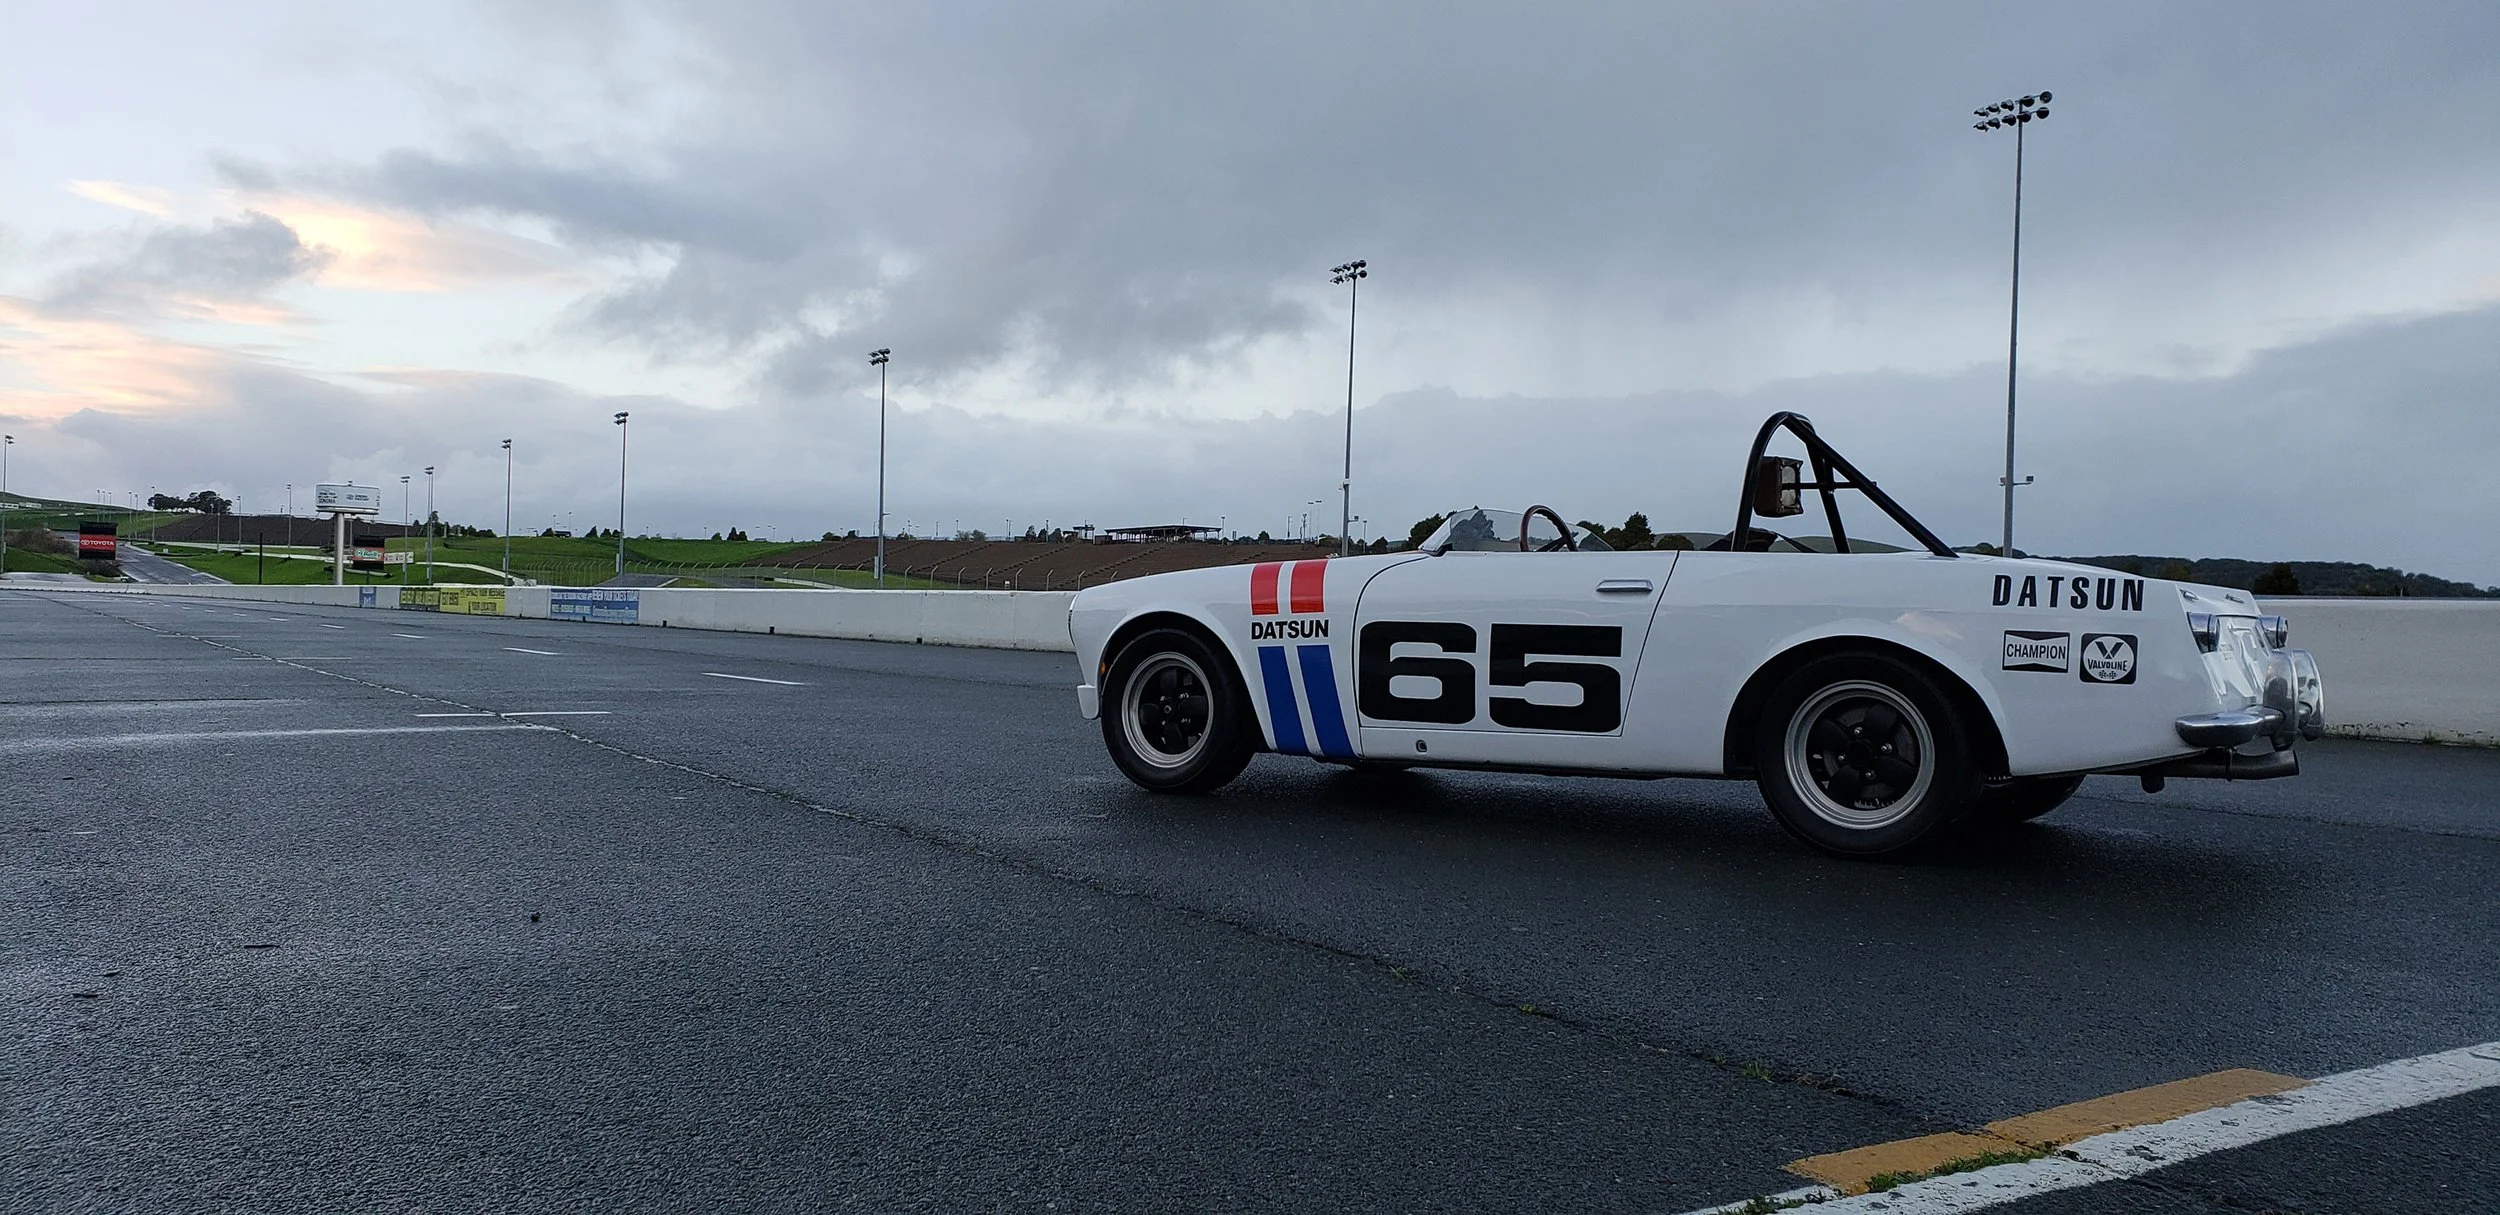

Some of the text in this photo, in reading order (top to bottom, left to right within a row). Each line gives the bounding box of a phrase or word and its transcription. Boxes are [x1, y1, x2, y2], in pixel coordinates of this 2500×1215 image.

[1992, 574, 2144, 611] DATSUN
[1251, 619, 1330, 640] DATSUN
[2006, 643, 2066, 660] CHAMPION
[2087, 658, 2128, 672] VALVOLINE
[1358, 620, 1623, 733] 65
